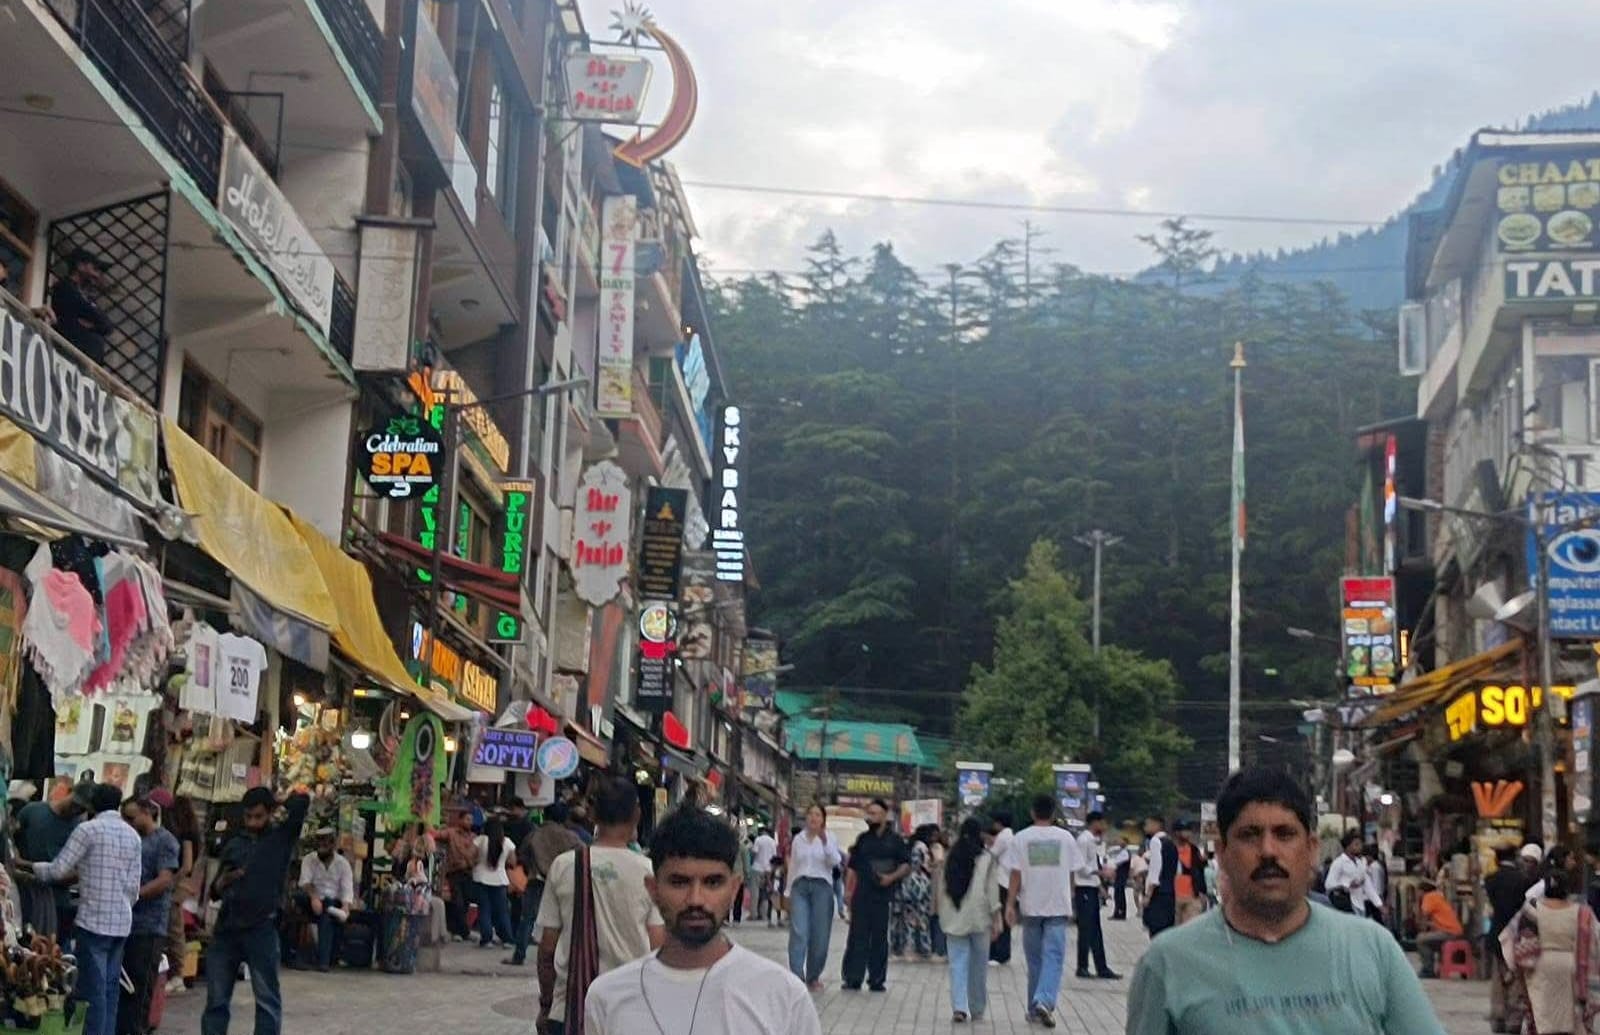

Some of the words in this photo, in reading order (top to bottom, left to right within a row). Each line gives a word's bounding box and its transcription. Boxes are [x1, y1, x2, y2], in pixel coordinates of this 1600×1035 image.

[226, 172, 284, 254] Hotel
[609, 244, 627, 275] 7
[0, 307, 118, 479] HOTEL
[366, 433, 439, 453] Celebration
[723, 406, 740, 464] SKY
[371, 452, 432, 475] SPA
[721, 468, 738, 528] BAR
[502, 492, 526, 572] PURE
[231, 667, 249, 690] 200
[471, 743, 534, 768] SOFTY
